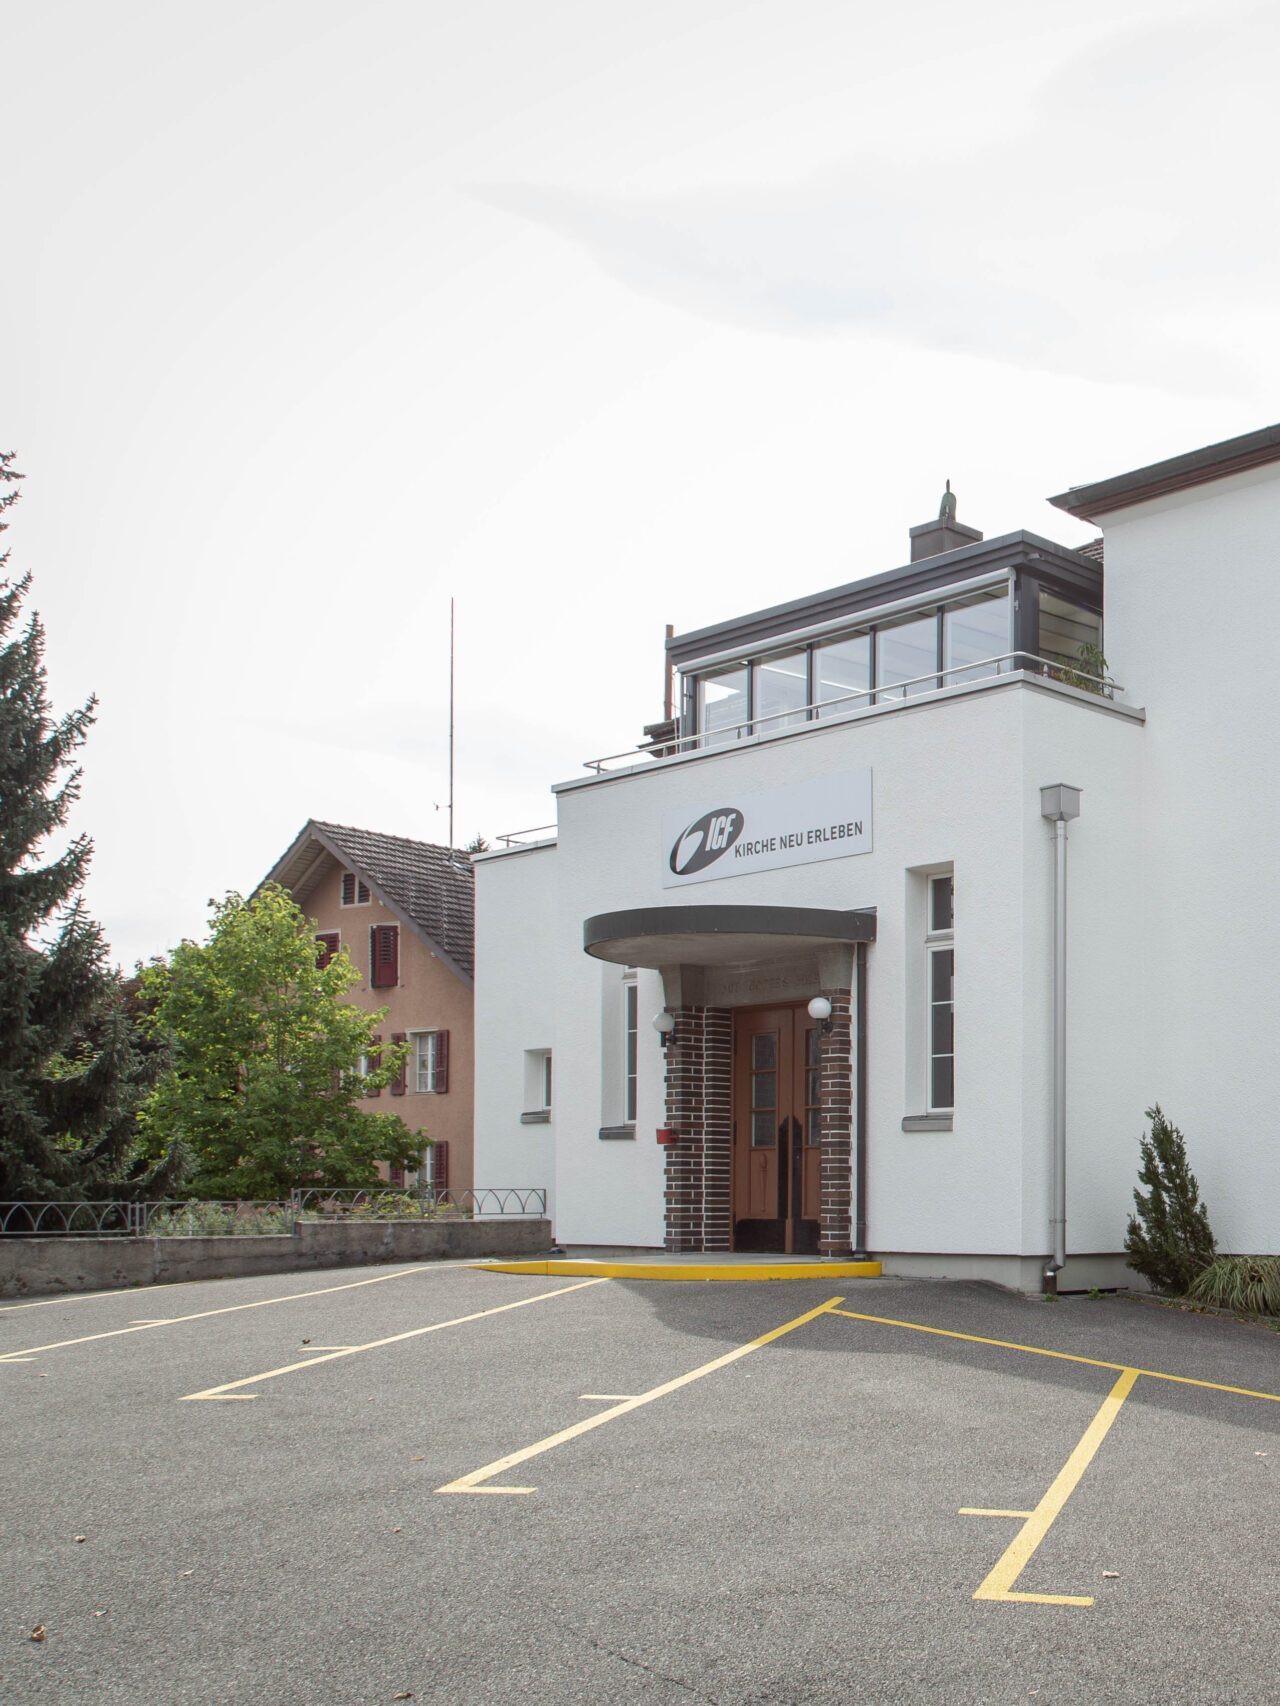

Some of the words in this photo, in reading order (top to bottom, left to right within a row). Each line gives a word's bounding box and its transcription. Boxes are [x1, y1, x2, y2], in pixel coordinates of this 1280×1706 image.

[705, 813, 737, 851] ICF
[734, 837, 777, 859] KIRCHE
[779, 831, 804, 851] NEU
[806, 820, 864, 845] ERLEBEN
